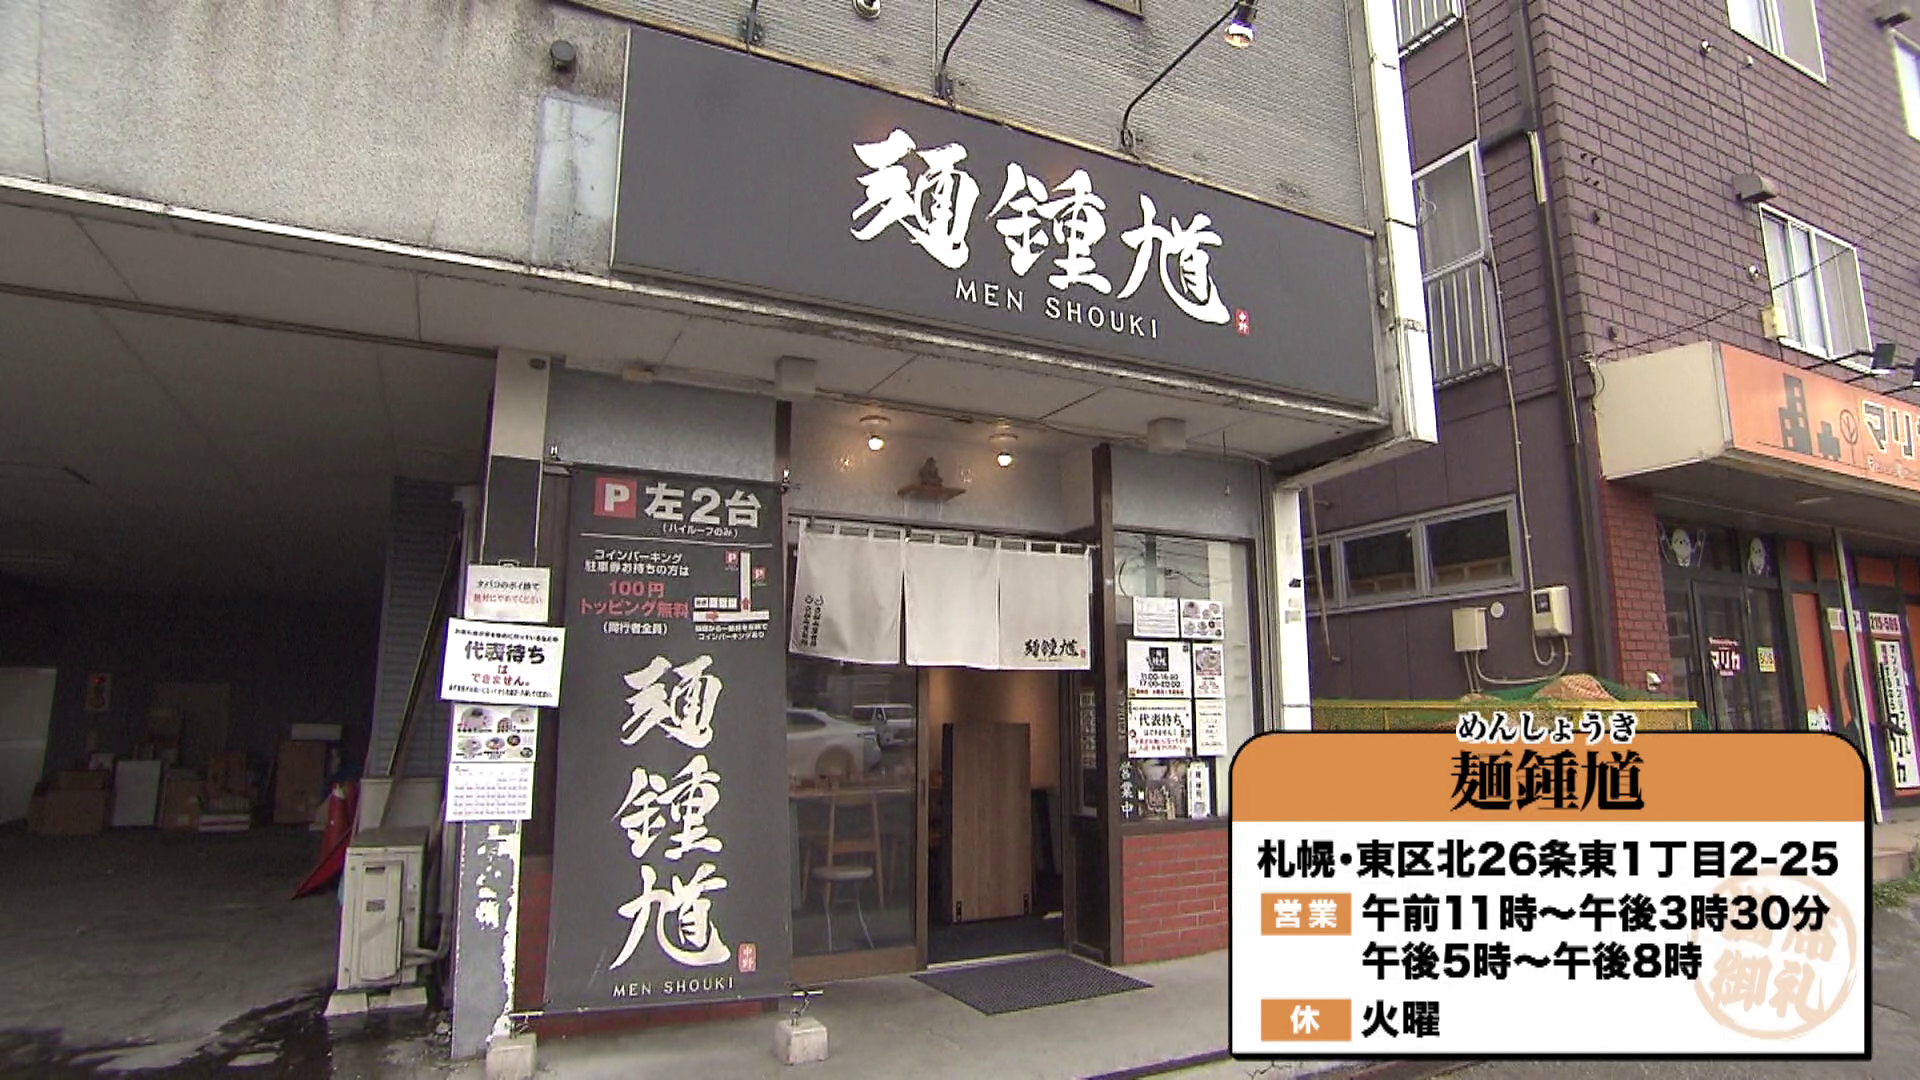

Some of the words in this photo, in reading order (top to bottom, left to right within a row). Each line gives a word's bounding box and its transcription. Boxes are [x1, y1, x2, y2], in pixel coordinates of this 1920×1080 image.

[955, 278, 1025, 312] MEN
[1045, 297, 1159, 339] SHOUKI
[1862, 399, 1920, 459] マリ
[604, 483, 630, 512] P
[644, 482, 762, 528] 左2台
[584, 559, 690, 577] 駐車券お持ちの方は
[608, 581, 665, 597] 100円
[580, 596, 690, 618] トッピング無料
[464, 640, 546, 664] 代表待ち
[1709, 650, 1740, 671] マリカ
[497, 664, 509, 675] は
[612, 982, 652, 997] MEN
[664, 976, 735, 995] SHOUKI
